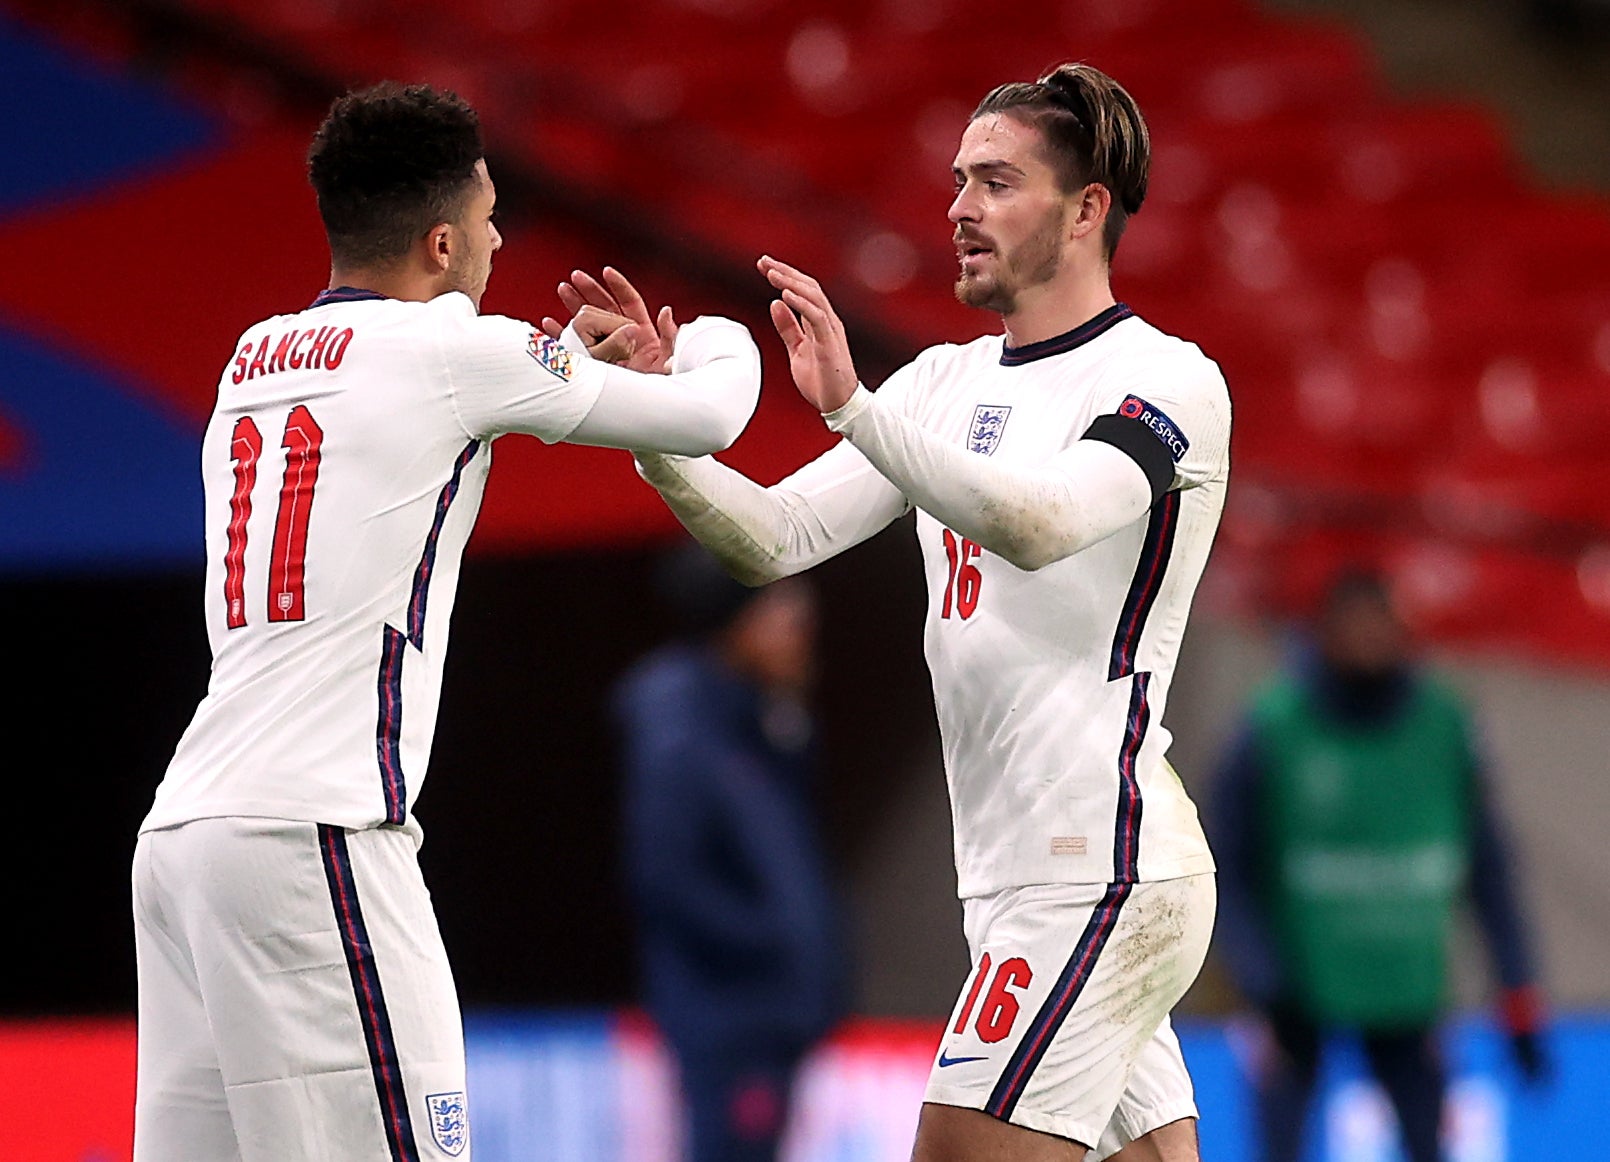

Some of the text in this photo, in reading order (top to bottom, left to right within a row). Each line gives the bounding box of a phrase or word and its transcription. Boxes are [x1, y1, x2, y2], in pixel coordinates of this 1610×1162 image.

[232, 326, 353, 385] SANCHO
[1140, 410, 1187, 459] RESPECT
[224, 405, 323, 629] 11
[941, 528, 982, 620] 16
[953, 952, 1033, 1043] 16
